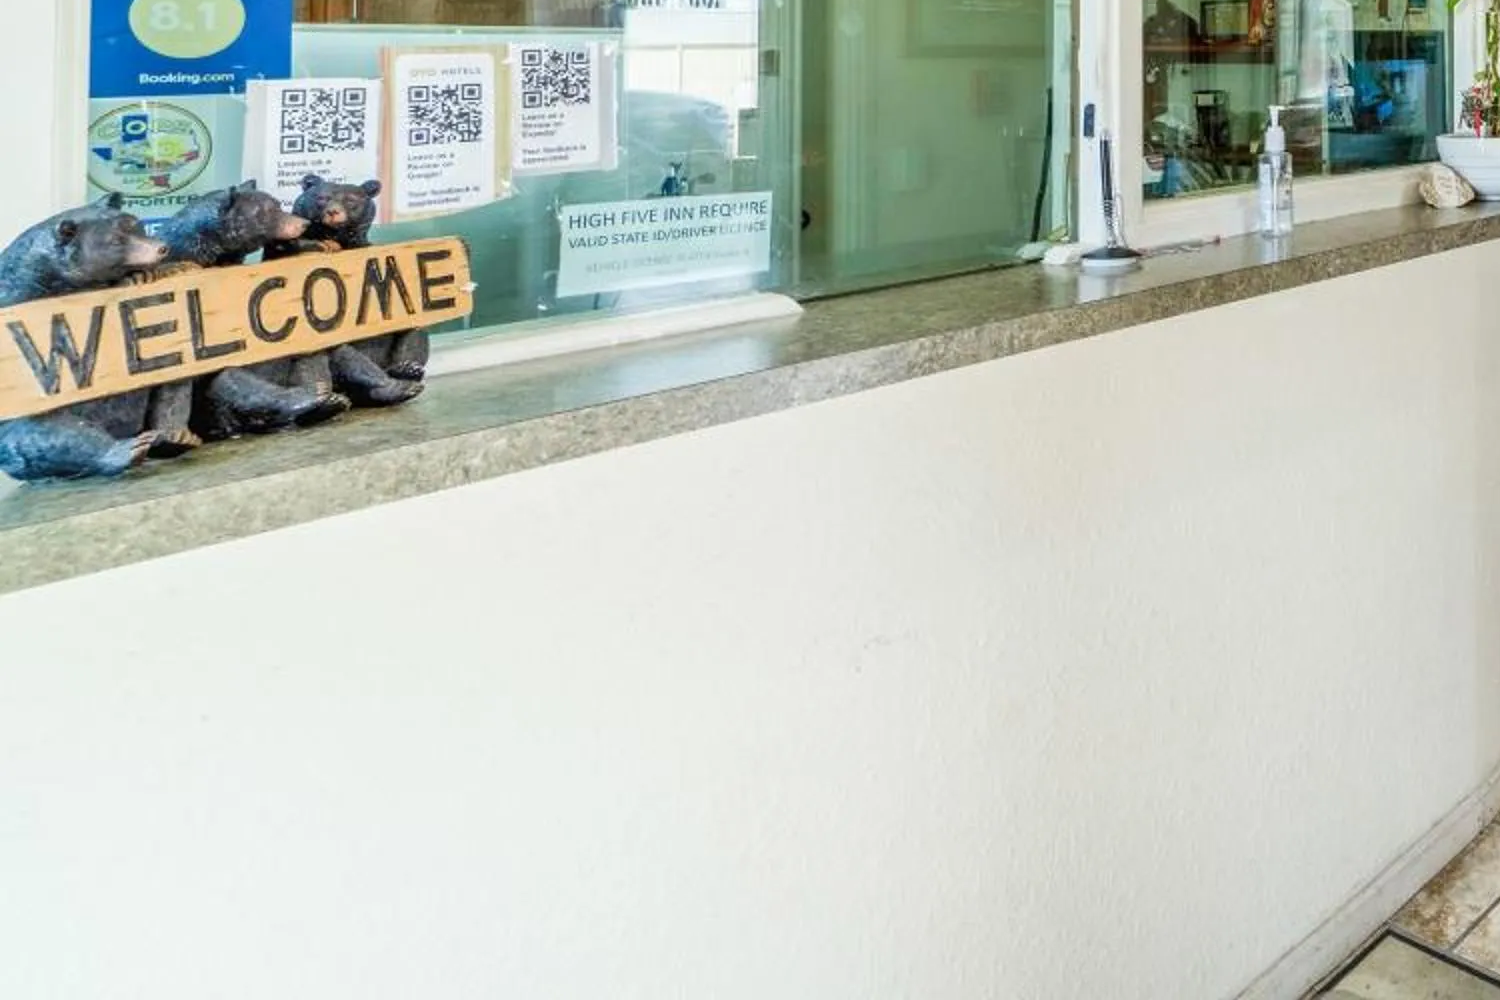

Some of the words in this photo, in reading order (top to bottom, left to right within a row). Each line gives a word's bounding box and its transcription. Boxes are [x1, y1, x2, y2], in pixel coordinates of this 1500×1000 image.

[150, 0, 217, 31] 8.1
[139, 72, 235, 84] Booking.com
[569, 213, 615, 229] HIGH
[622, 209, 657, 225] FIVE
[664, 206, 695, 222] INN
[700, 200, 768, 218] REQUIRE
[568, 236, 608, 249] VALID
[612, 231, 649, 245] STATE
[653, 226, 717, 242] ID/DRIVER
[6, 250, 457, 396] WELCOME
